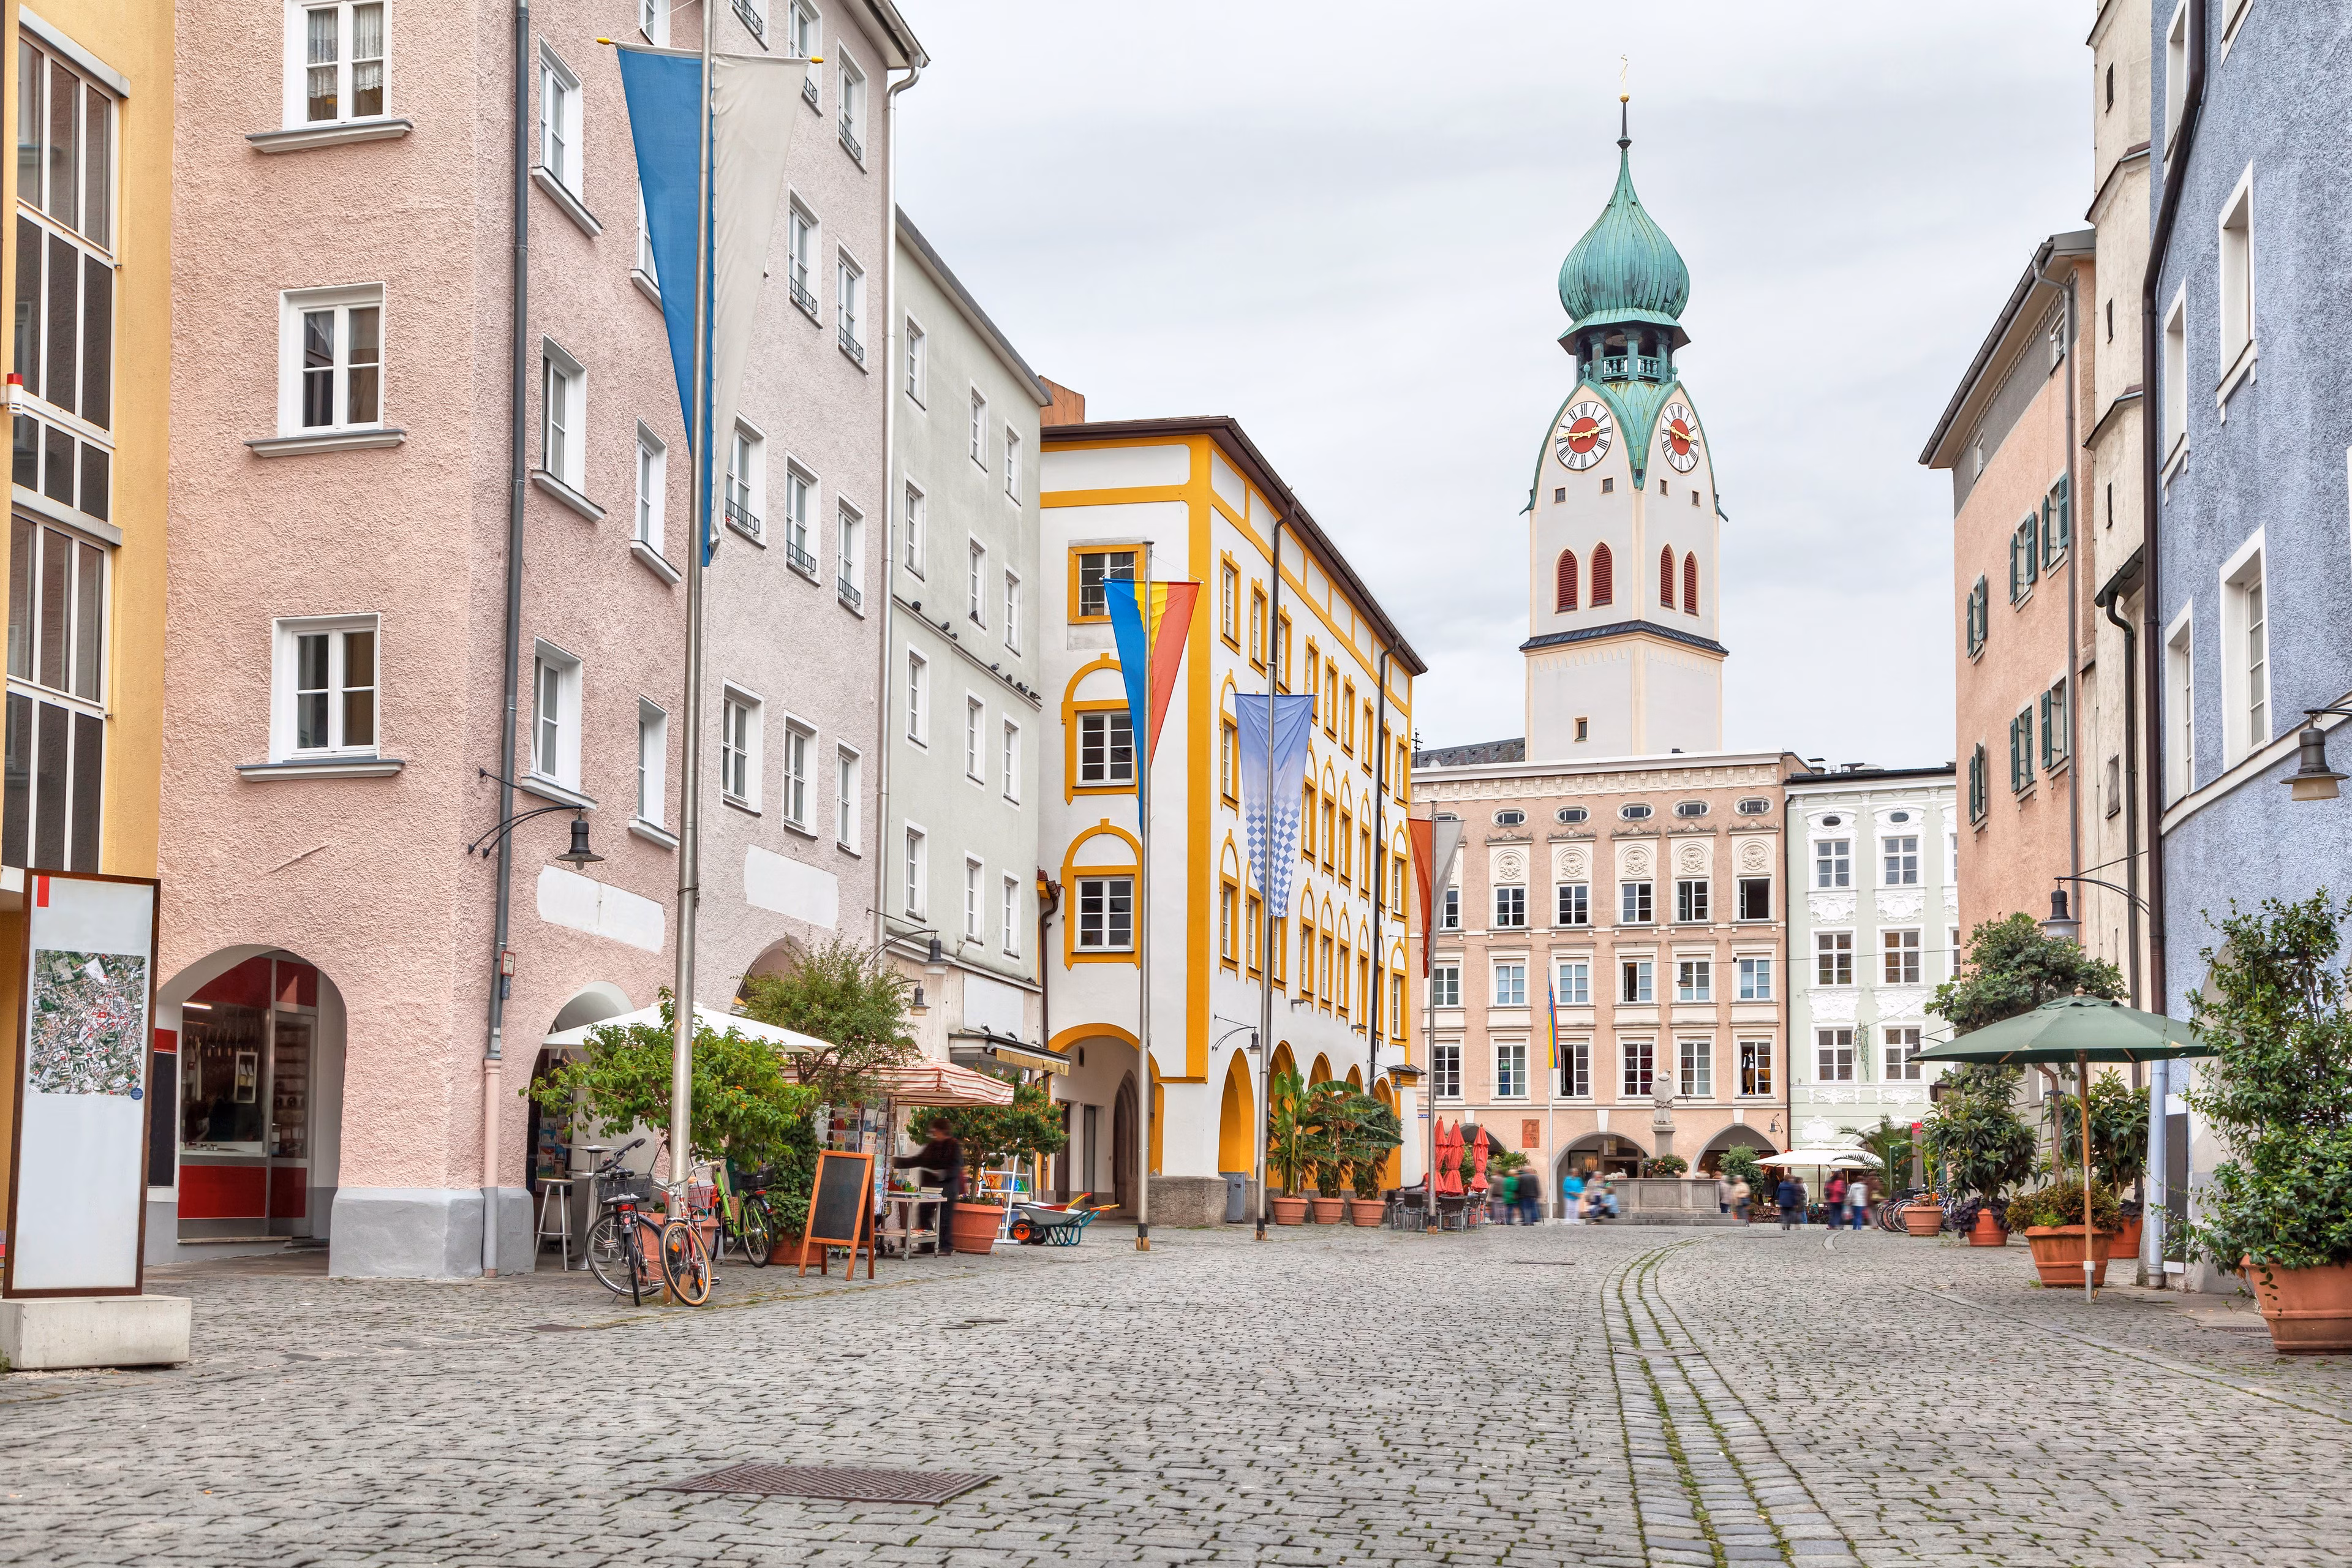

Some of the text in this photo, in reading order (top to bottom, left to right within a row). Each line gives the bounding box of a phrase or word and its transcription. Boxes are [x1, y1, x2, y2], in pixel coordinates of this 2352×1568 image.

[1569, 409, 1578, 423] XI
[1592, 404, 1598, 417] I
[1597, 413, 1608, 424] II
[1685, 412, 1689, 423] I
[1597, 439, 1609, 450] IIII
[1559, 445, 1571, 460] VIII
[1591, 450, 1599, 461] V
[1689, 448, 1697, 461] IIII
[1567, 453, 1577, 467] VII
[1581, 454, 1586, 467] VI
[1685, 455, 1691, 468] V
